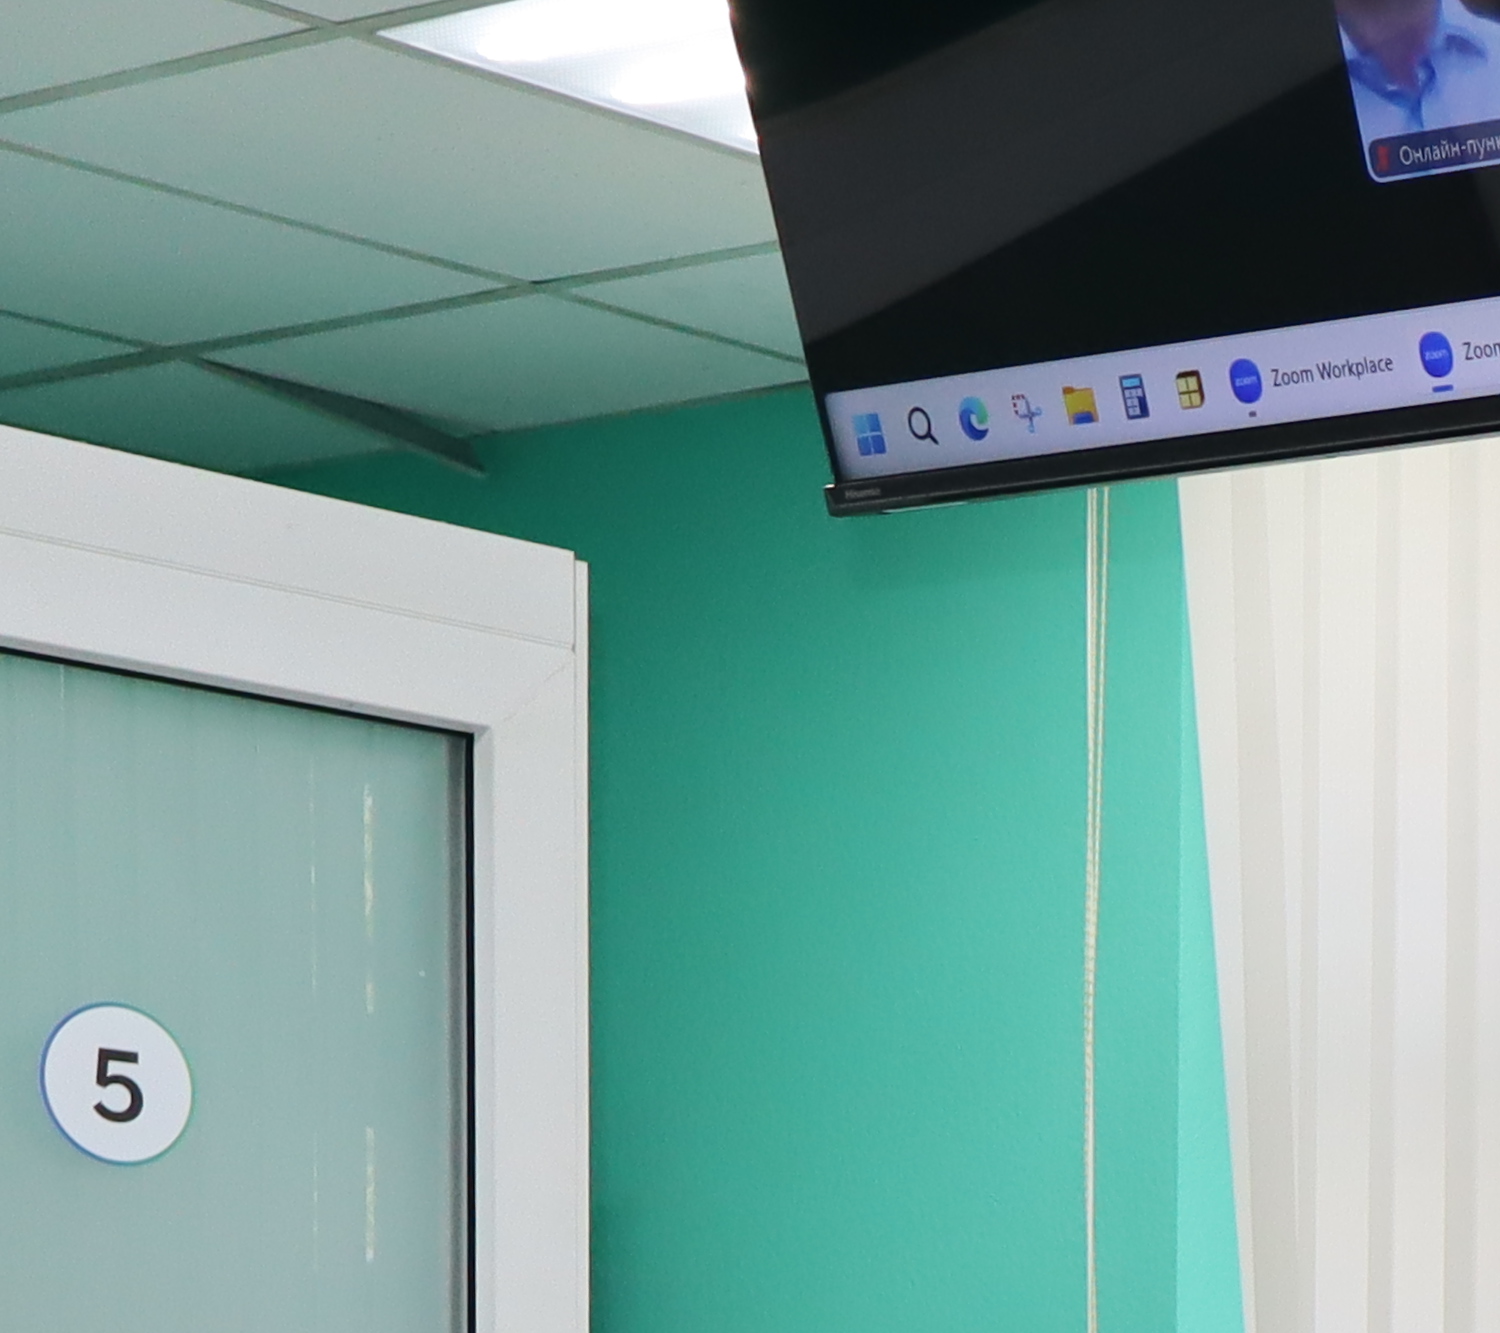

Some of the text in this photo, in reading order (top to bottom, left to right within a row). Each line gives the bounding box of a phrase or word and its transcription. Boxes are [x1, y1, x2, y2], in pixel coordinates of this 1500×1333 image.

[1271, 356, 1394, 387] Zoom Workplace
[93, 1047, 144, 1123] 5
